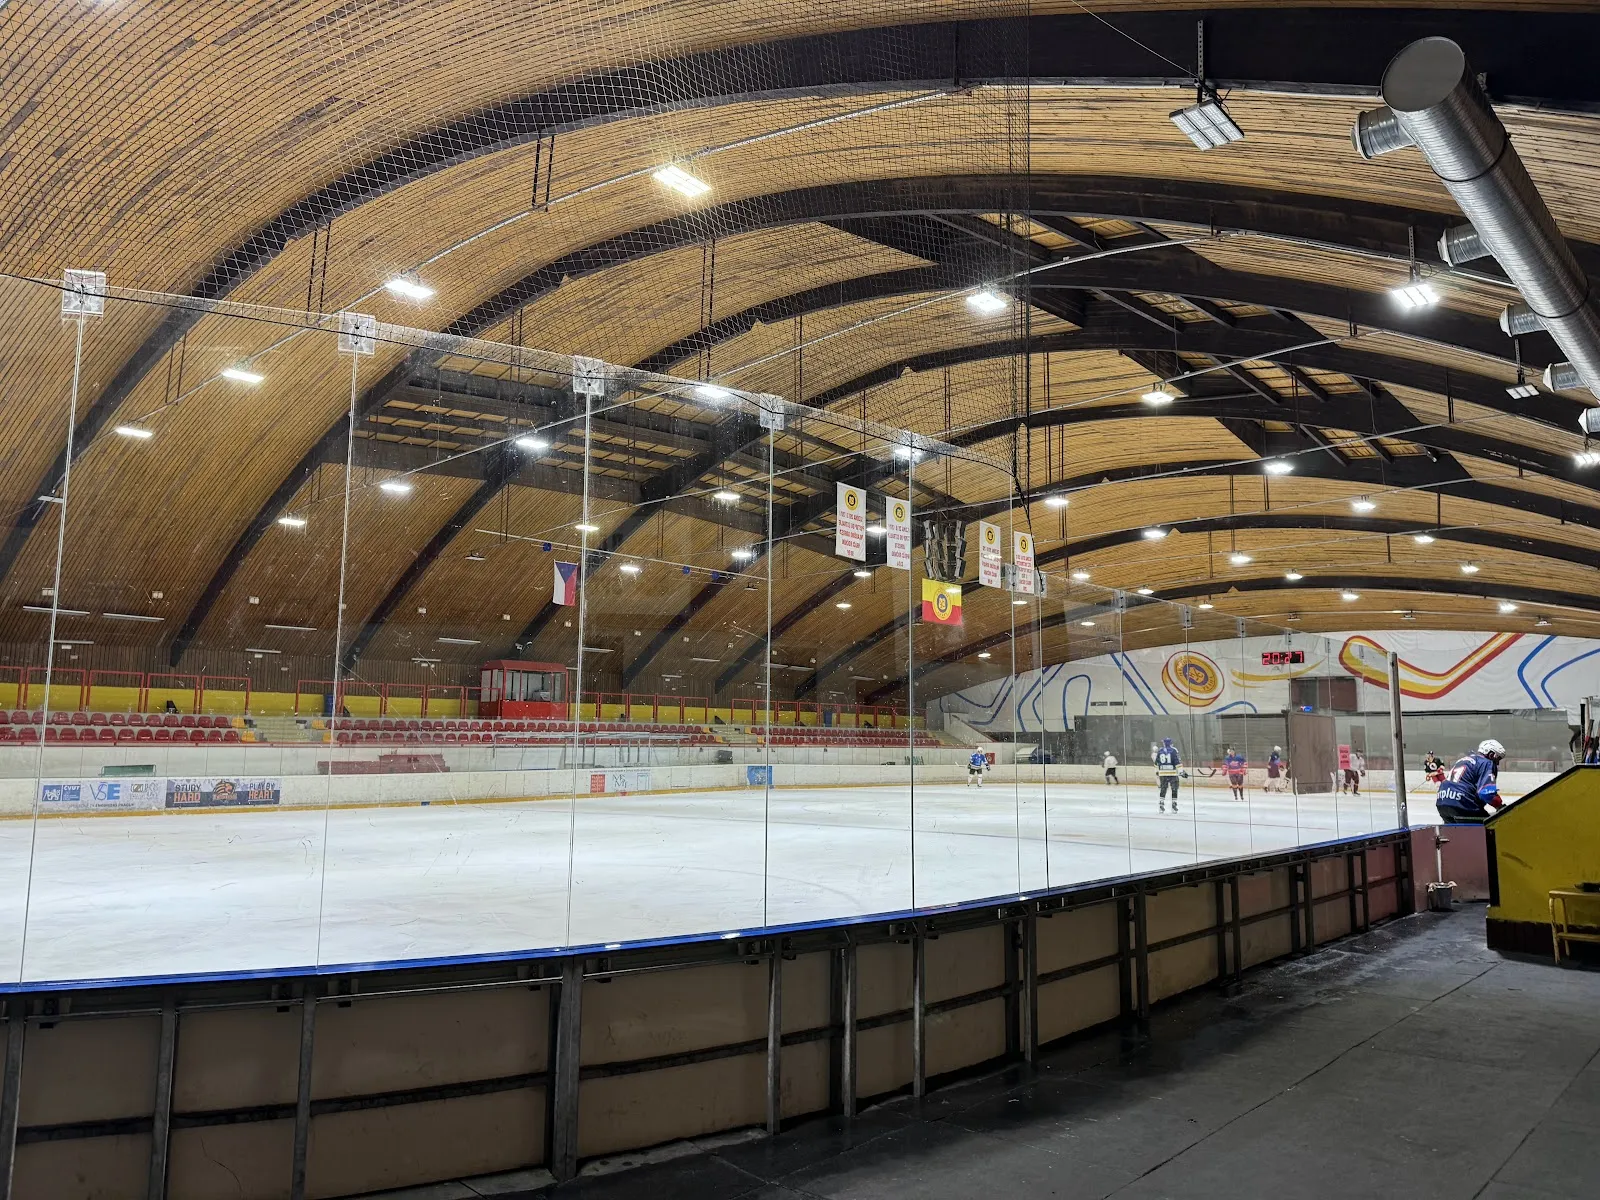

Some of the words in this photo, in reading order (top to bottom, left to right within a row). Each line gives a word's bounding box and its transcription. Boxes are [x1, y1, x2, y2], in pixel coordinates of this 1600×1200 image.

[175, 784, 202, 792] STUDY
[249, 782, 265, 791] PLAY
[266, 783, 275, 791] BY
[174, 792, 200, 801] HARD
[249, 790, 273, 800] HEART
